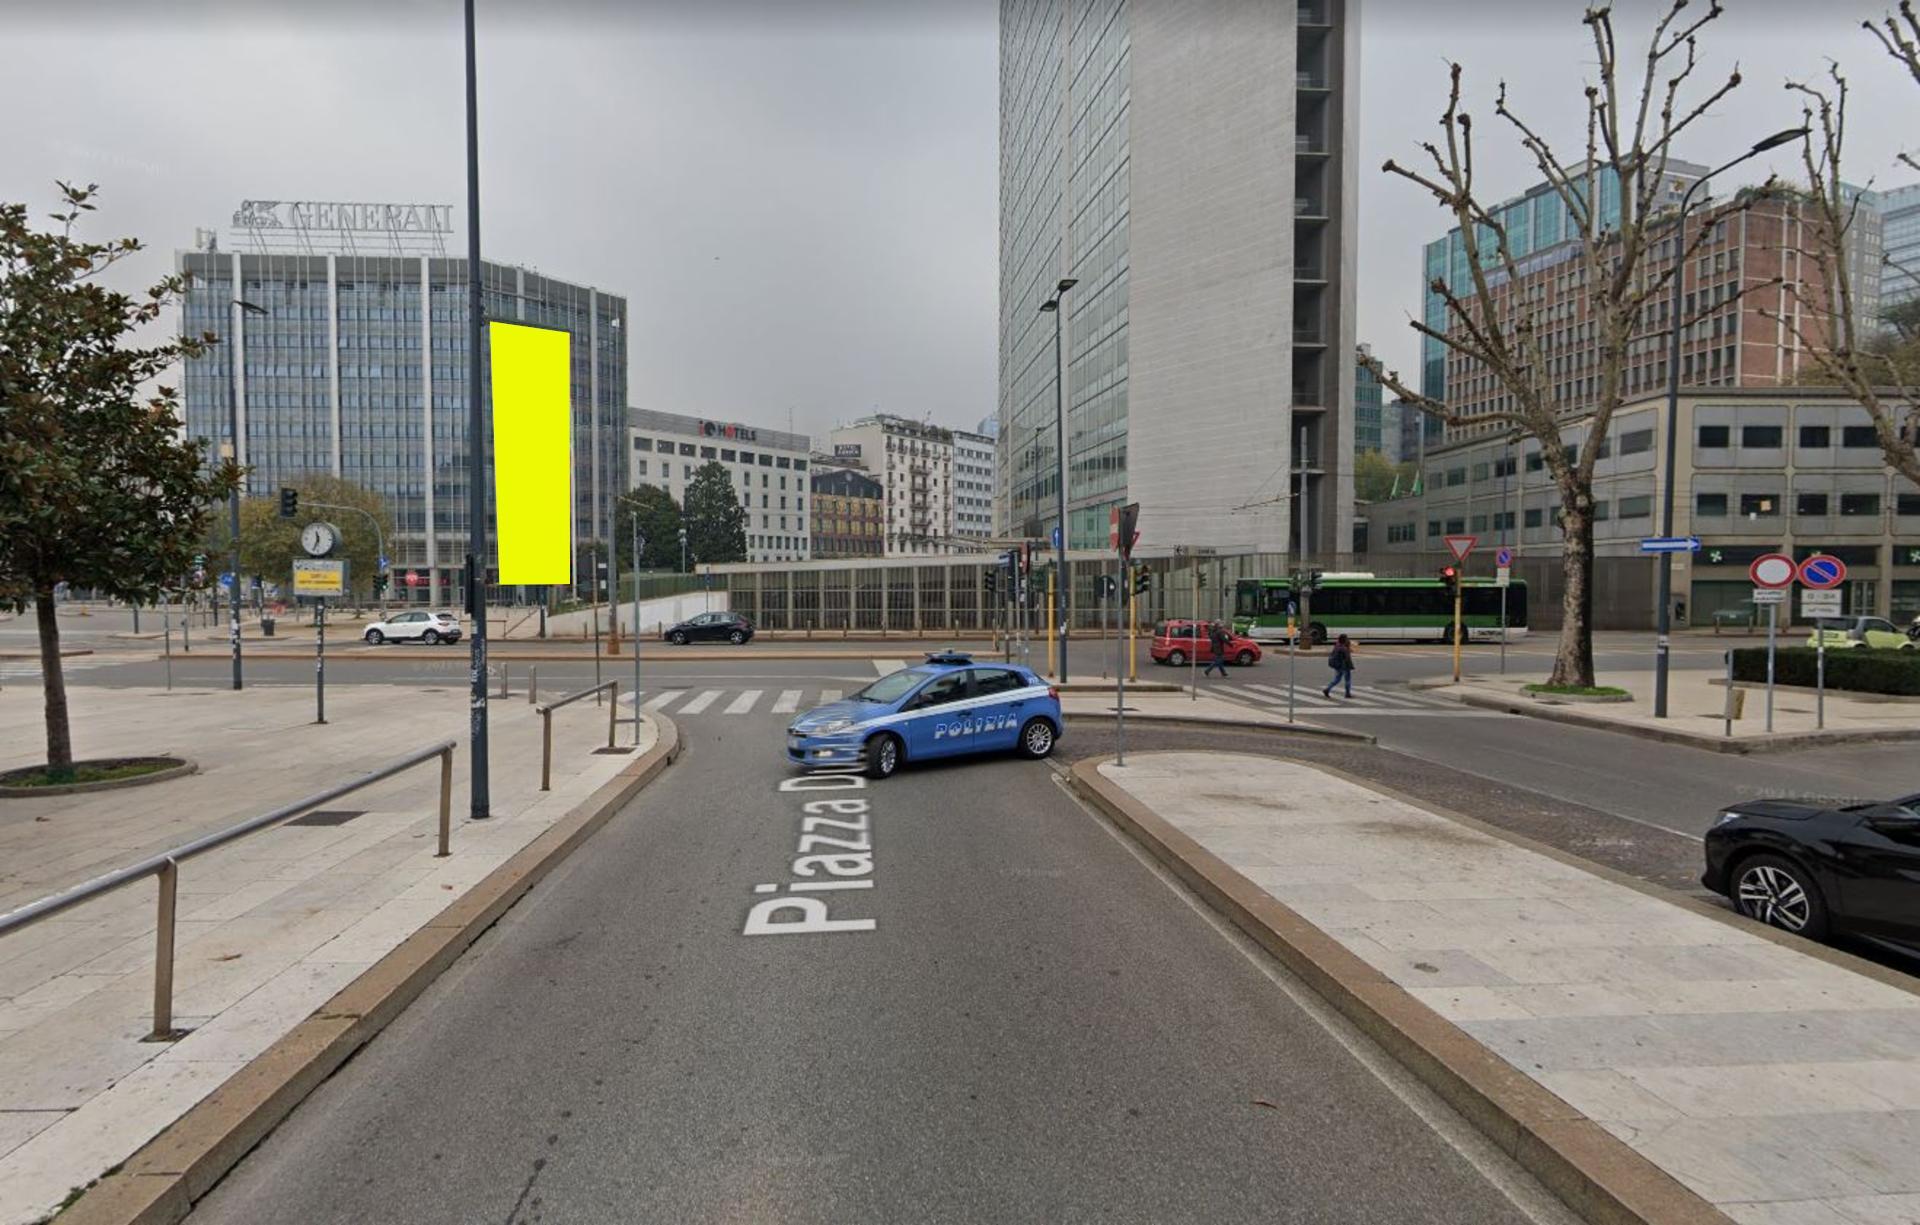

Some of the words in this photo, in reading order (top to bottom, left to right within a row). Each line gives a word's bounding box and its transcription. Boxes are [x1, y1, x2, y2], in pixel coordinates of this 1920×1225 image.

[292, 203, 453, 232] GENERALI
[719, 424, 756, 441] HOTELS
[934, 713, 1018, 739] POLIZIA
